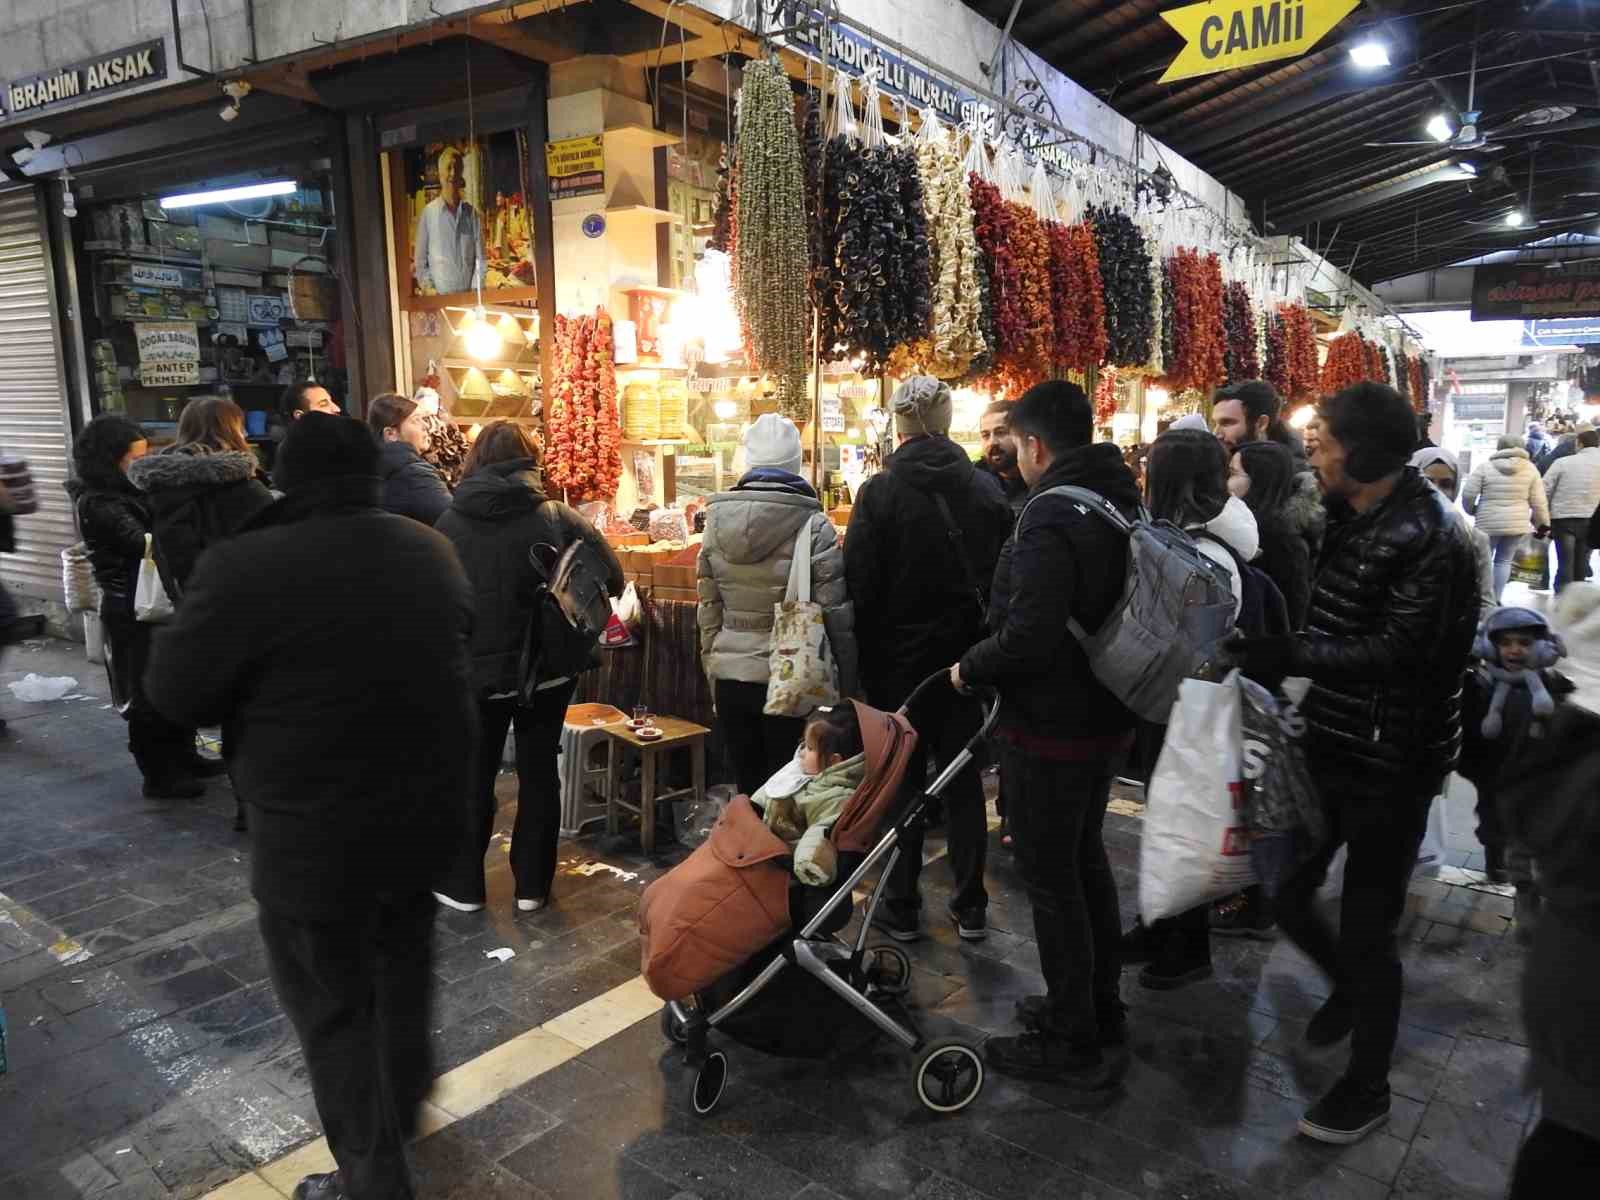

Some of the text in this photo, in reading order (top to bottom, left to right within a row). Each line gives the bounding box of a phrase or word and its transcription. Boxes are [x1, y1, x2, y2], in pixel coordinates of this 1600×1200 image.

[8, 50, 153, 112] İBRAHİM AKSAK
[156, 363, 194, 373] ANTEP
